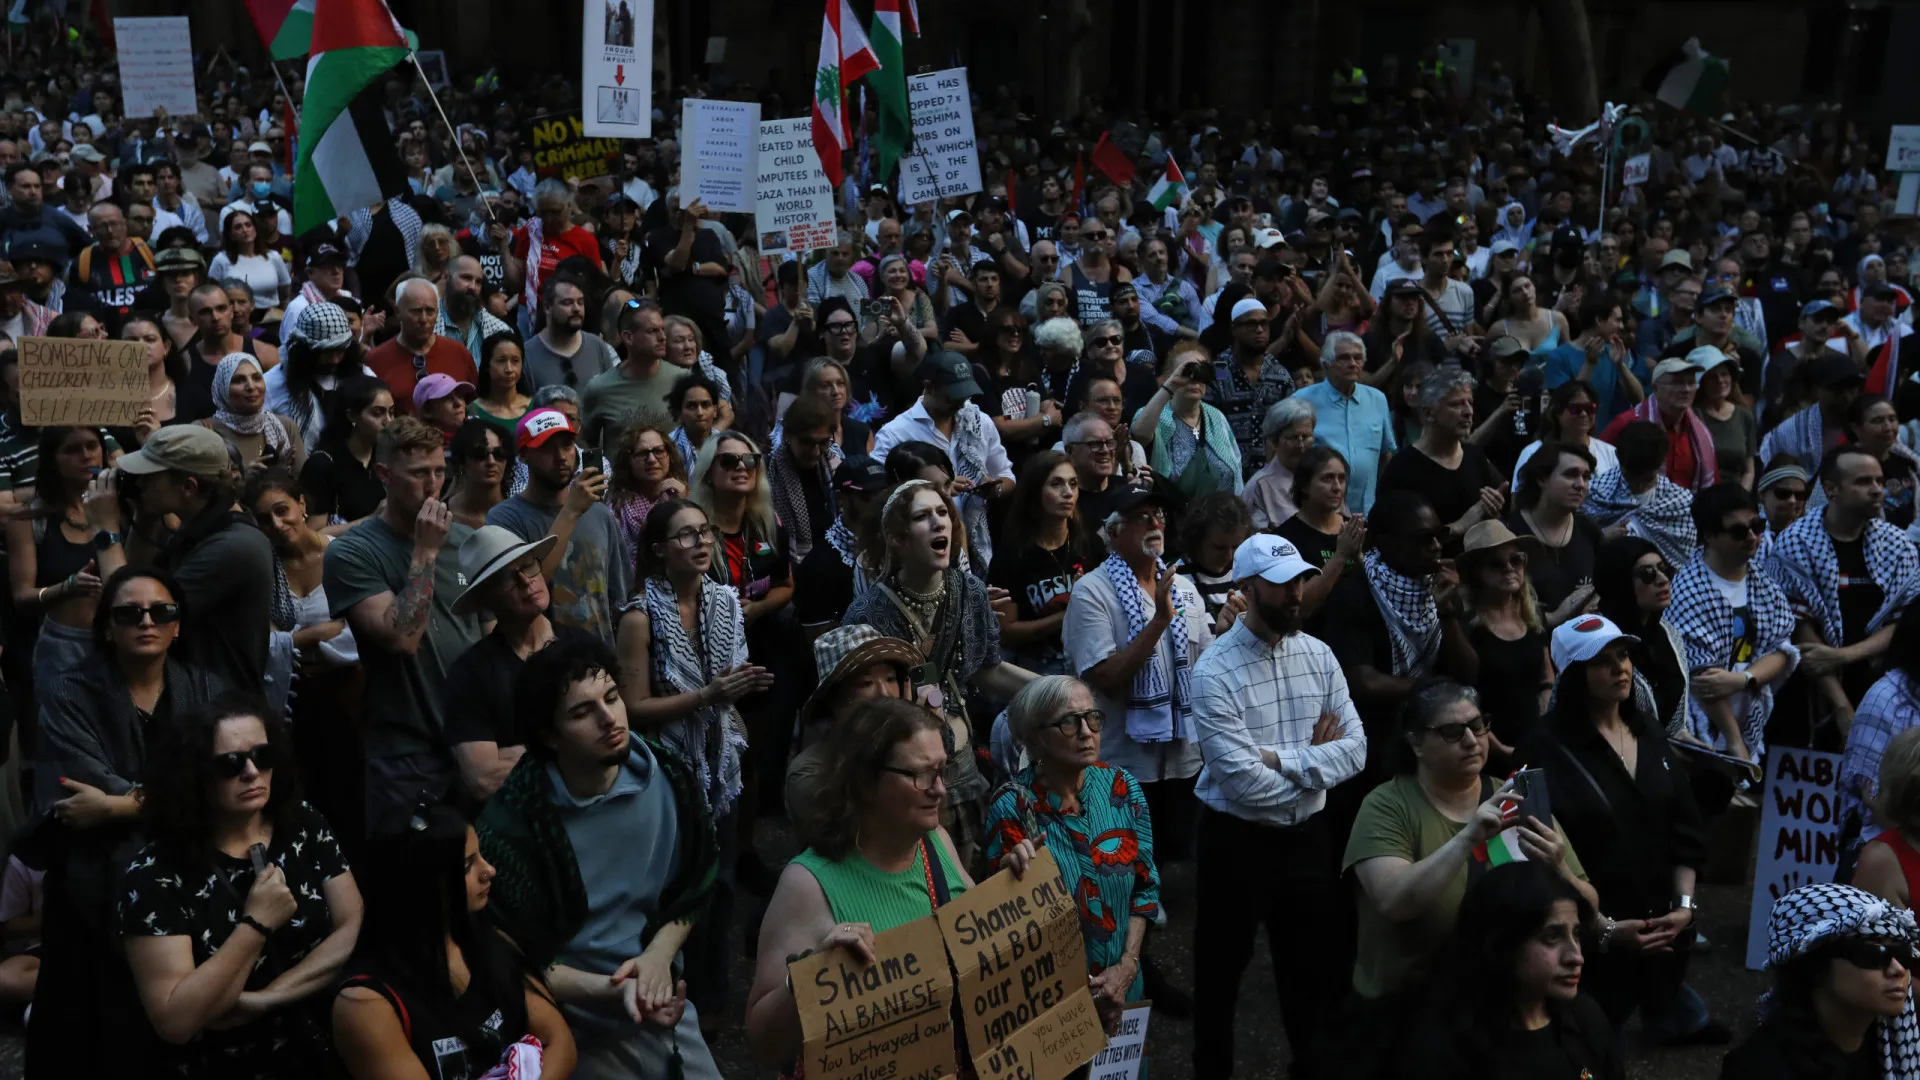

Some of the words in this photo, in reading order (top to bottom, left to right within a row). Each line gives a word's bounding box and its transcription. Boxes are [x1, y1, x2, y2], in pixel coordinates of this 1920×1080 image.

[938, 78, 960, 88] HAS
[946, 95, 952, 104] 7
[533, 120, 567, 147] NO
[793, 122, 812, 132] HAS
[944, 127, 960, 137] ON
[936, 140, 974, 153] WHICH
[774, 154, 804, 166] CHILD
[910, 164, 920, 172] IS
[947, 156, 968, 166] THE
[946, 170, 959, 180] OF
[787, 186, 816, 197] THAN
[819, 184, 830, 194] IN
[776, 200, 813, 211] WORLD
[774, 212, 818, 225] HISTORY
[480, 254, 501, 265] NOT
[482, 265, 504, 280] OU
[1077, 289, 1098, 298] WHEN
[23, 341, 112, 368] BOMBING
[119, 343, 144, 368] ON
[22, 370, 92, 389] CHILDREN
[100, 372, 115, 390] IS
[25, 398, 72, 422] SELF
[954, 896, 1031, 945] Shame
[1032, 882, 1056, 907] on
[978, 919, 1042, 981] ALBO
[816, 953, 921, 1005] Shame
[974, 977, 1012, 1016] our
[1021, 951, 1055, 1000] pm
[826, 978, 940, 1041] ALBANESE
[1032, 1024, 1052, 1042] you
[1058, 1002, 1086, 1027] have
[819, 1054, 843, 1073] You
[849, 1024, 920, 1065] betrayed
[924, 1022, 950, 1038] our
[1109, 1046, 1124, 1064] TIES
[1124, 1042, 1142, 1062] WITH
